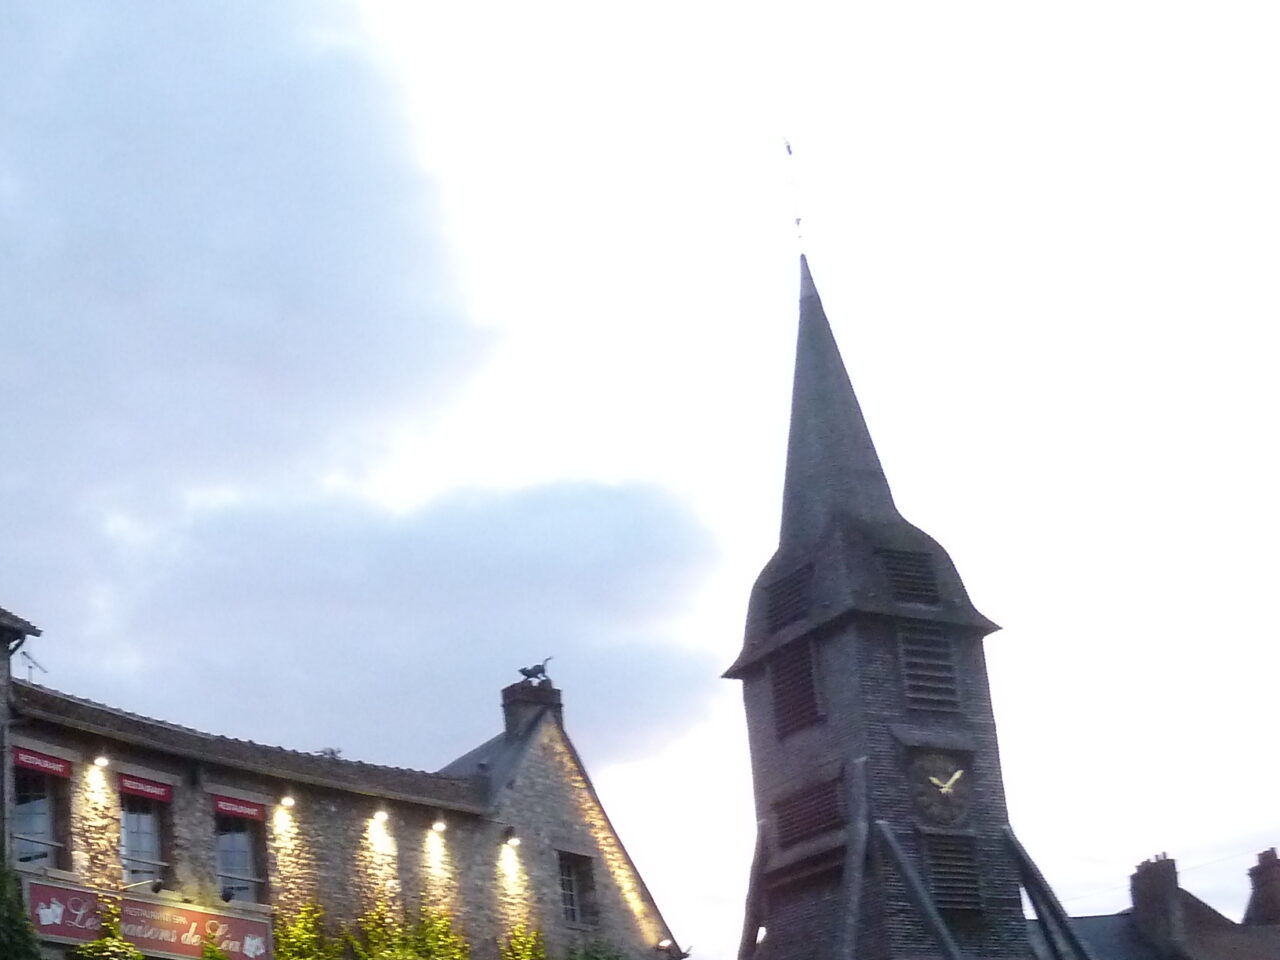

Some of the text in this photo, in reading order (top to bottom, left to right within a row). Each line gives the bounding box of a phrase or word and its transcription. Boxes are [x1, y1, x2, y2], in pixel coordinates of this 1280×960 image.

[18, 753, 65, 773] RESTAURANT
[122, 777, 167, 796] RESTAURANT
[217, 799, 259, 817] RESTAURANT
[121, 920, 178, 944] aisons
[181, 921, 203, 946] de
